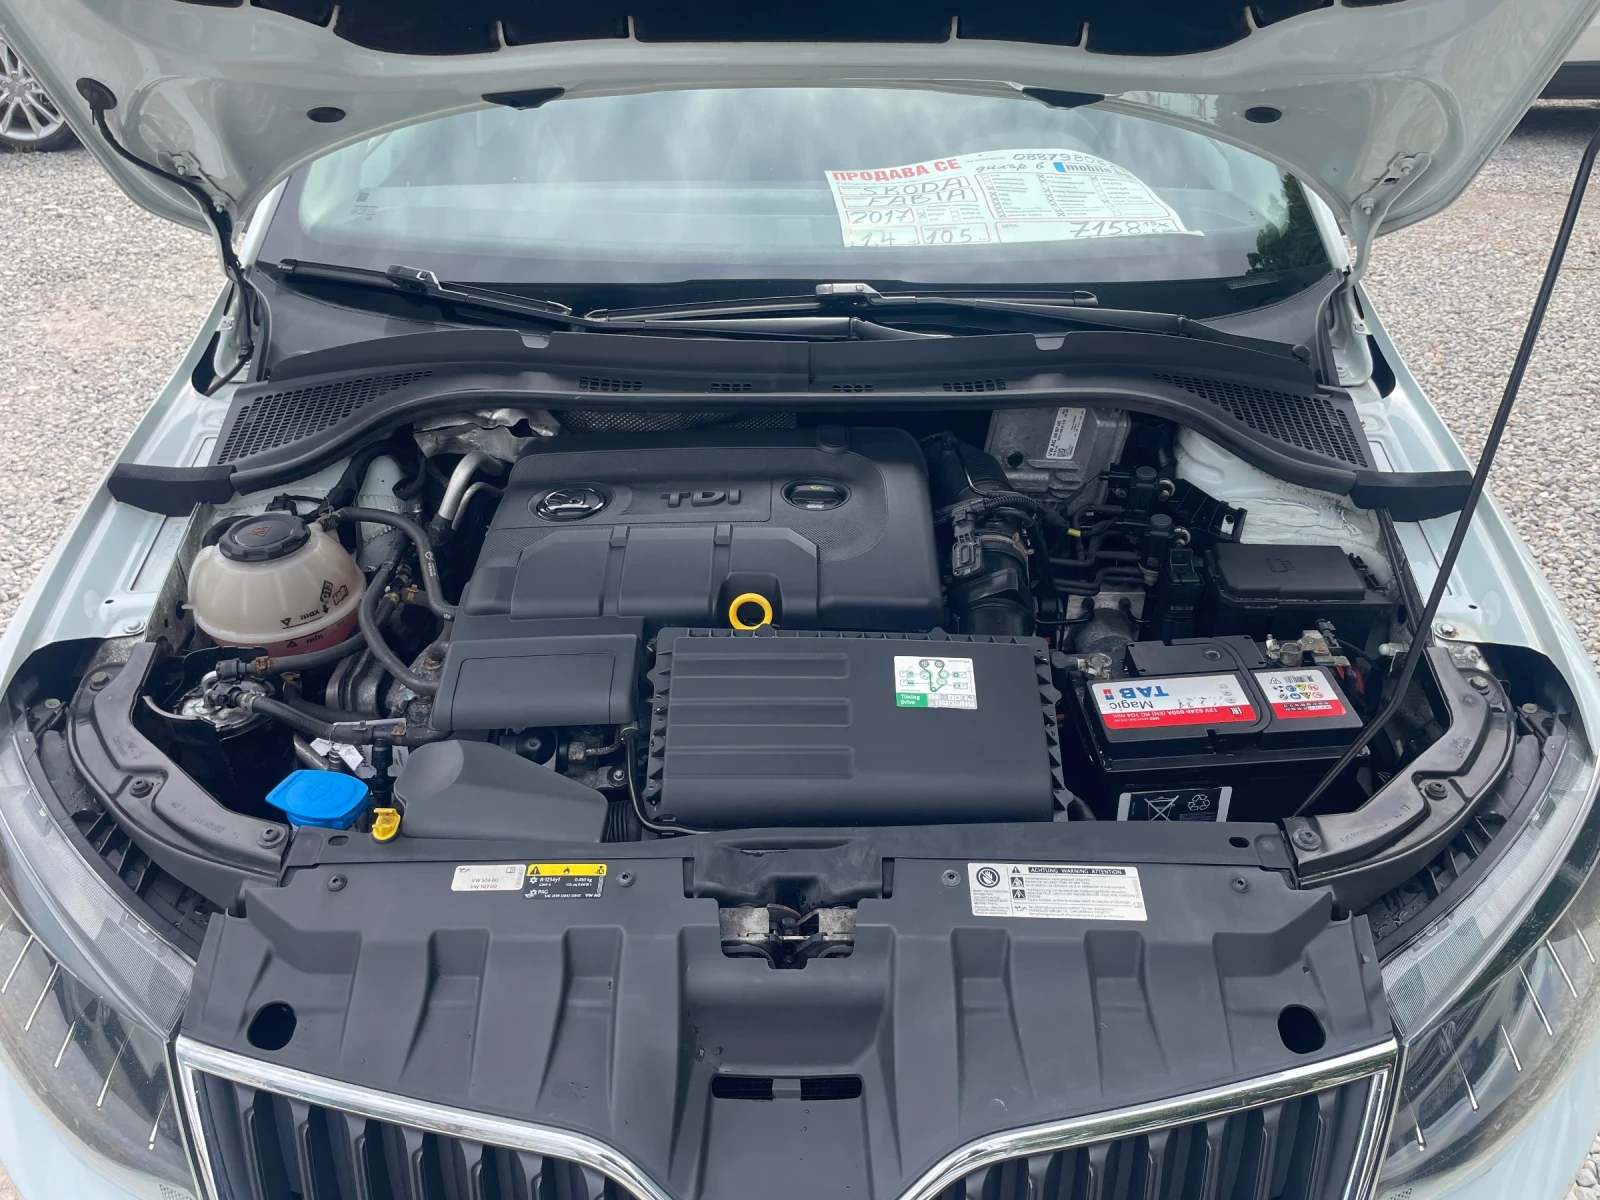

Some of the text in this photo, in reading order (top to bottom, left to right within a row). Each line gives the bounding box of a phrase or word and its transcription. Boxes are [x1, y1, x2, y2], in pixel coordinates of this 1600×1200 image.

[832, 158, 962, 182] ПРОДАВА СЕ
[860, 177, 963, 196] SKODA
[867, 188, 966, 207] FABIA
[850, 208, 910, 224] 2017
[925, 228, 972, 244] 105
[660, 489, 741, 508] TDI
[299, 609, 320, 621] max
[305, 633, 324, 644] min
[1118, 685, 1170, 699] TAB
[1108, 699, 1154, 710] Magic
